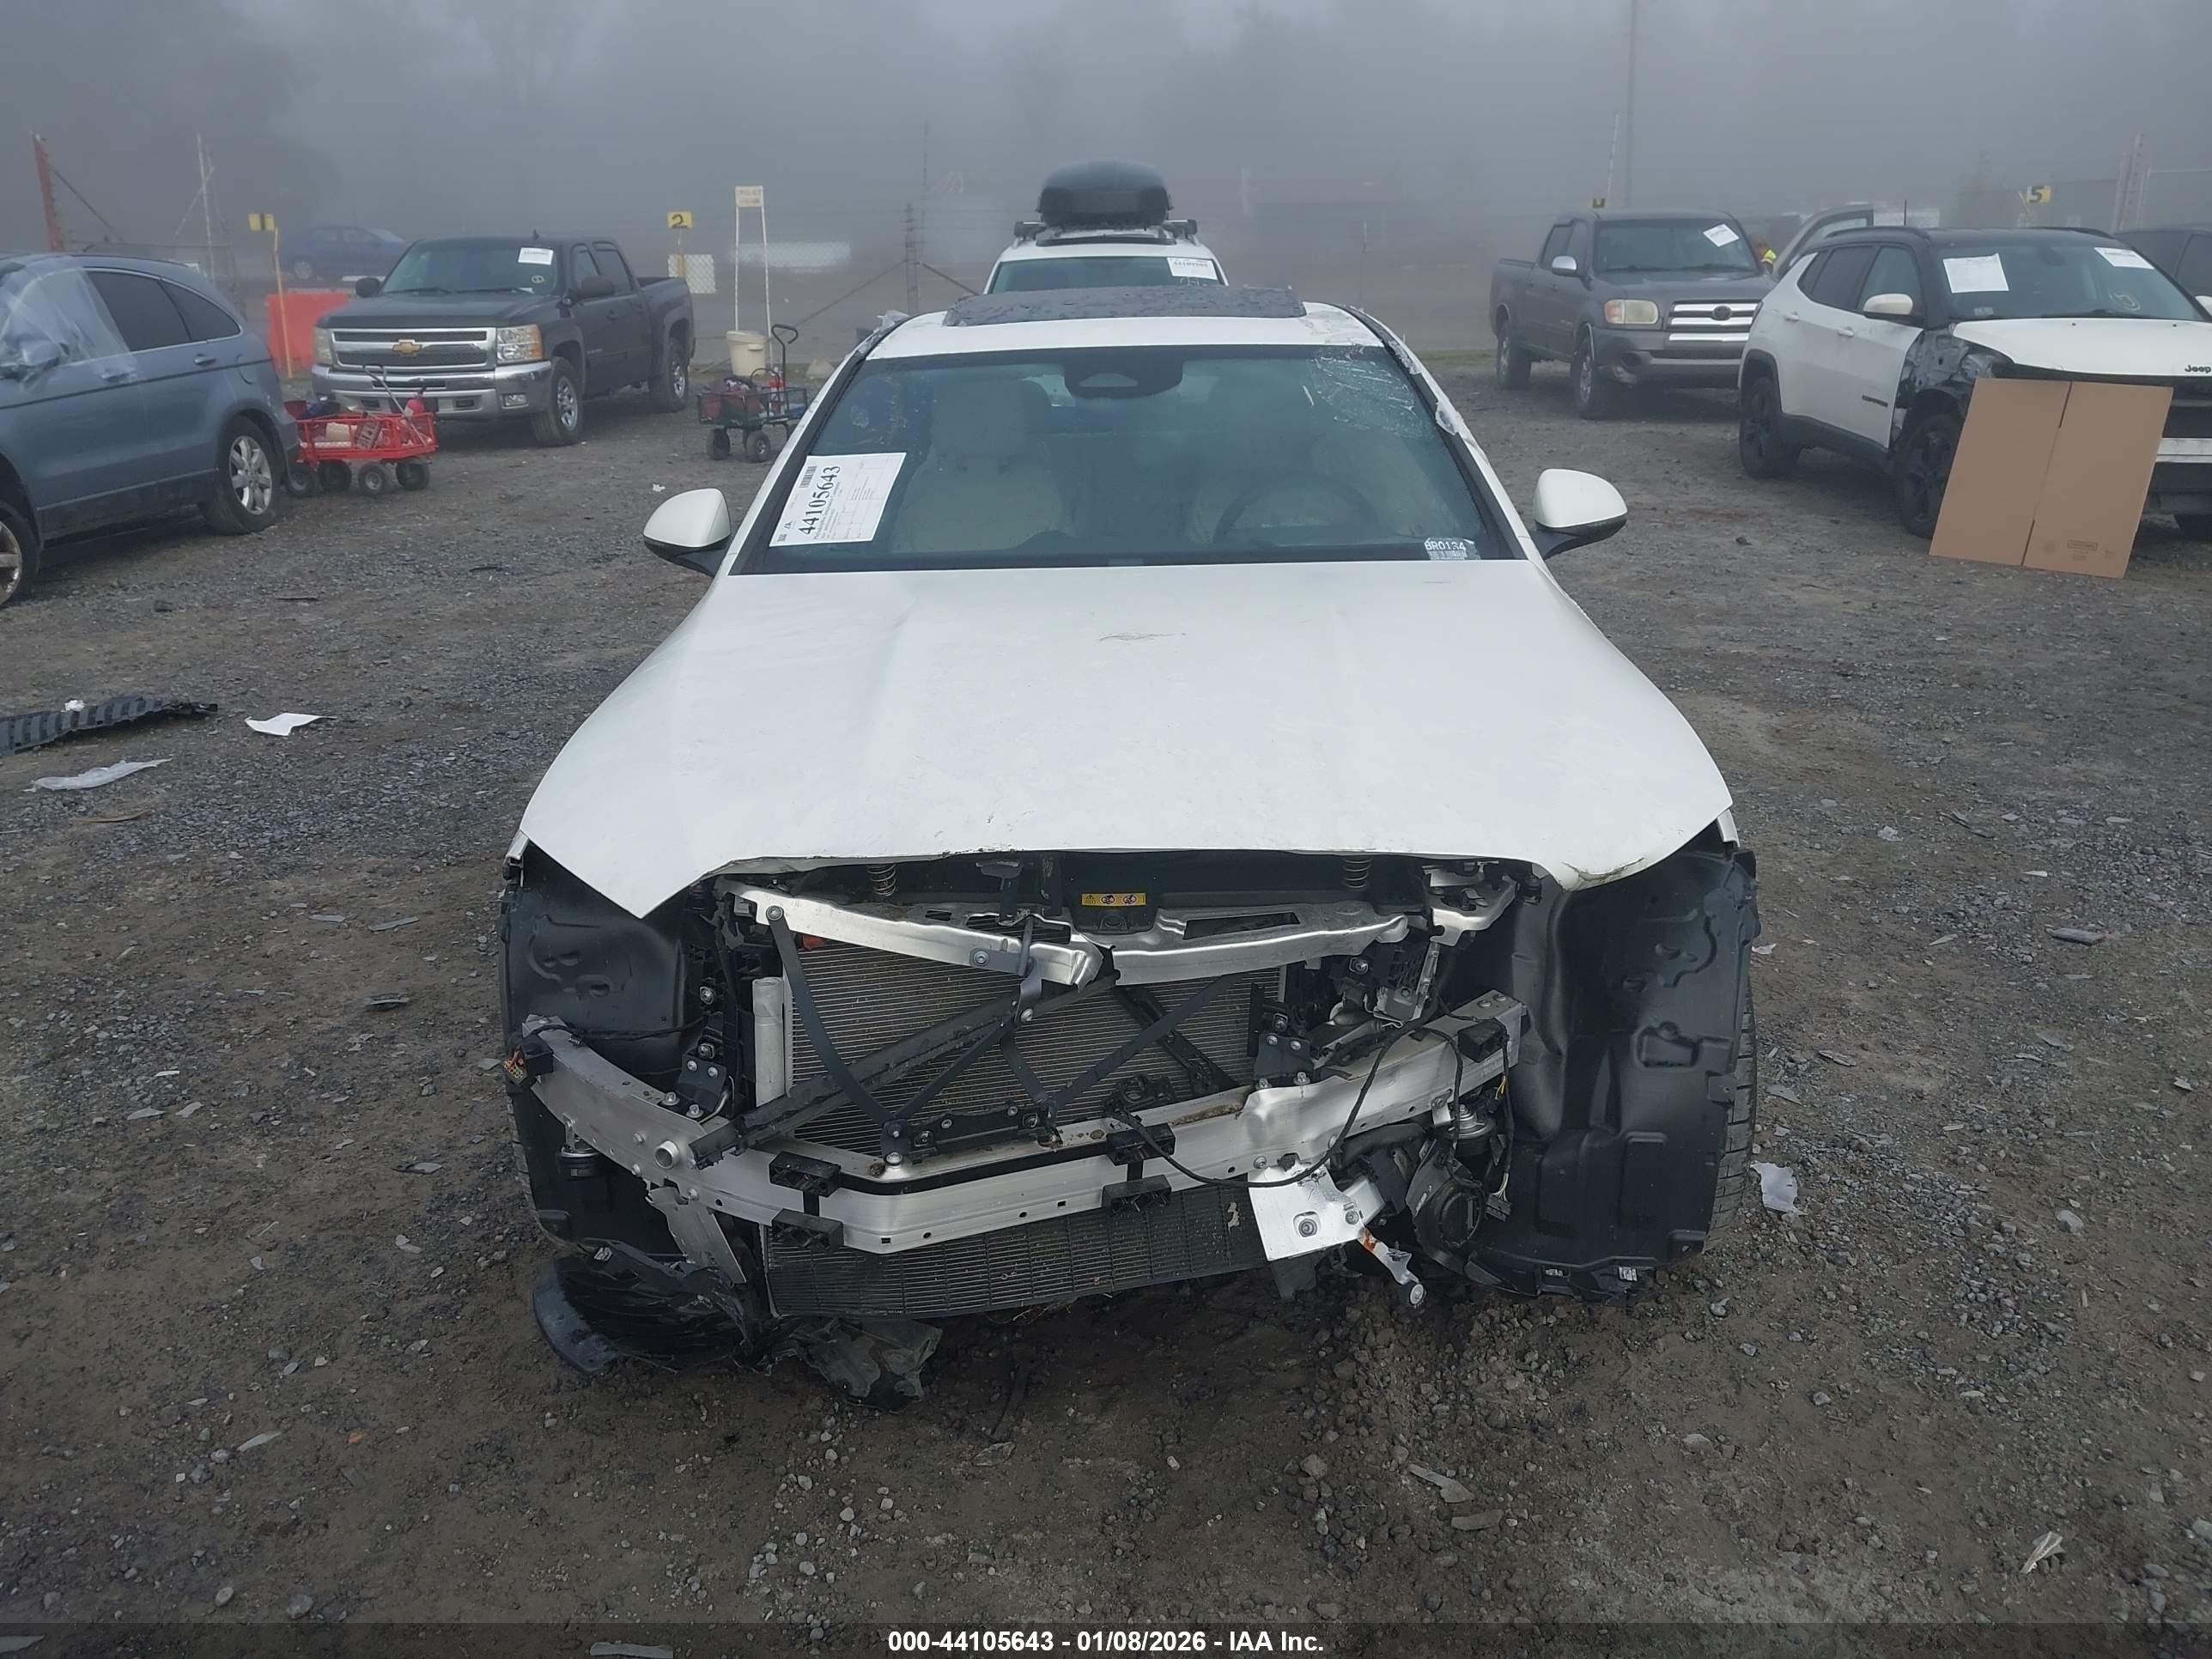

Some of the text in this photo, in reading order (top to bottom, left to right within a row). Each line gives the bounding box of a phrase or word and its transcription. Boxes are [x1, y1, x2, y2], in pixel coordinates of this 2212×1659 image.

[2029, 185, 2042, 204] 5
[671, 213, 688, 228] 2
[2184, 364, 2212, 374] Jeep
[798, 465, 841, 536] 44105643
